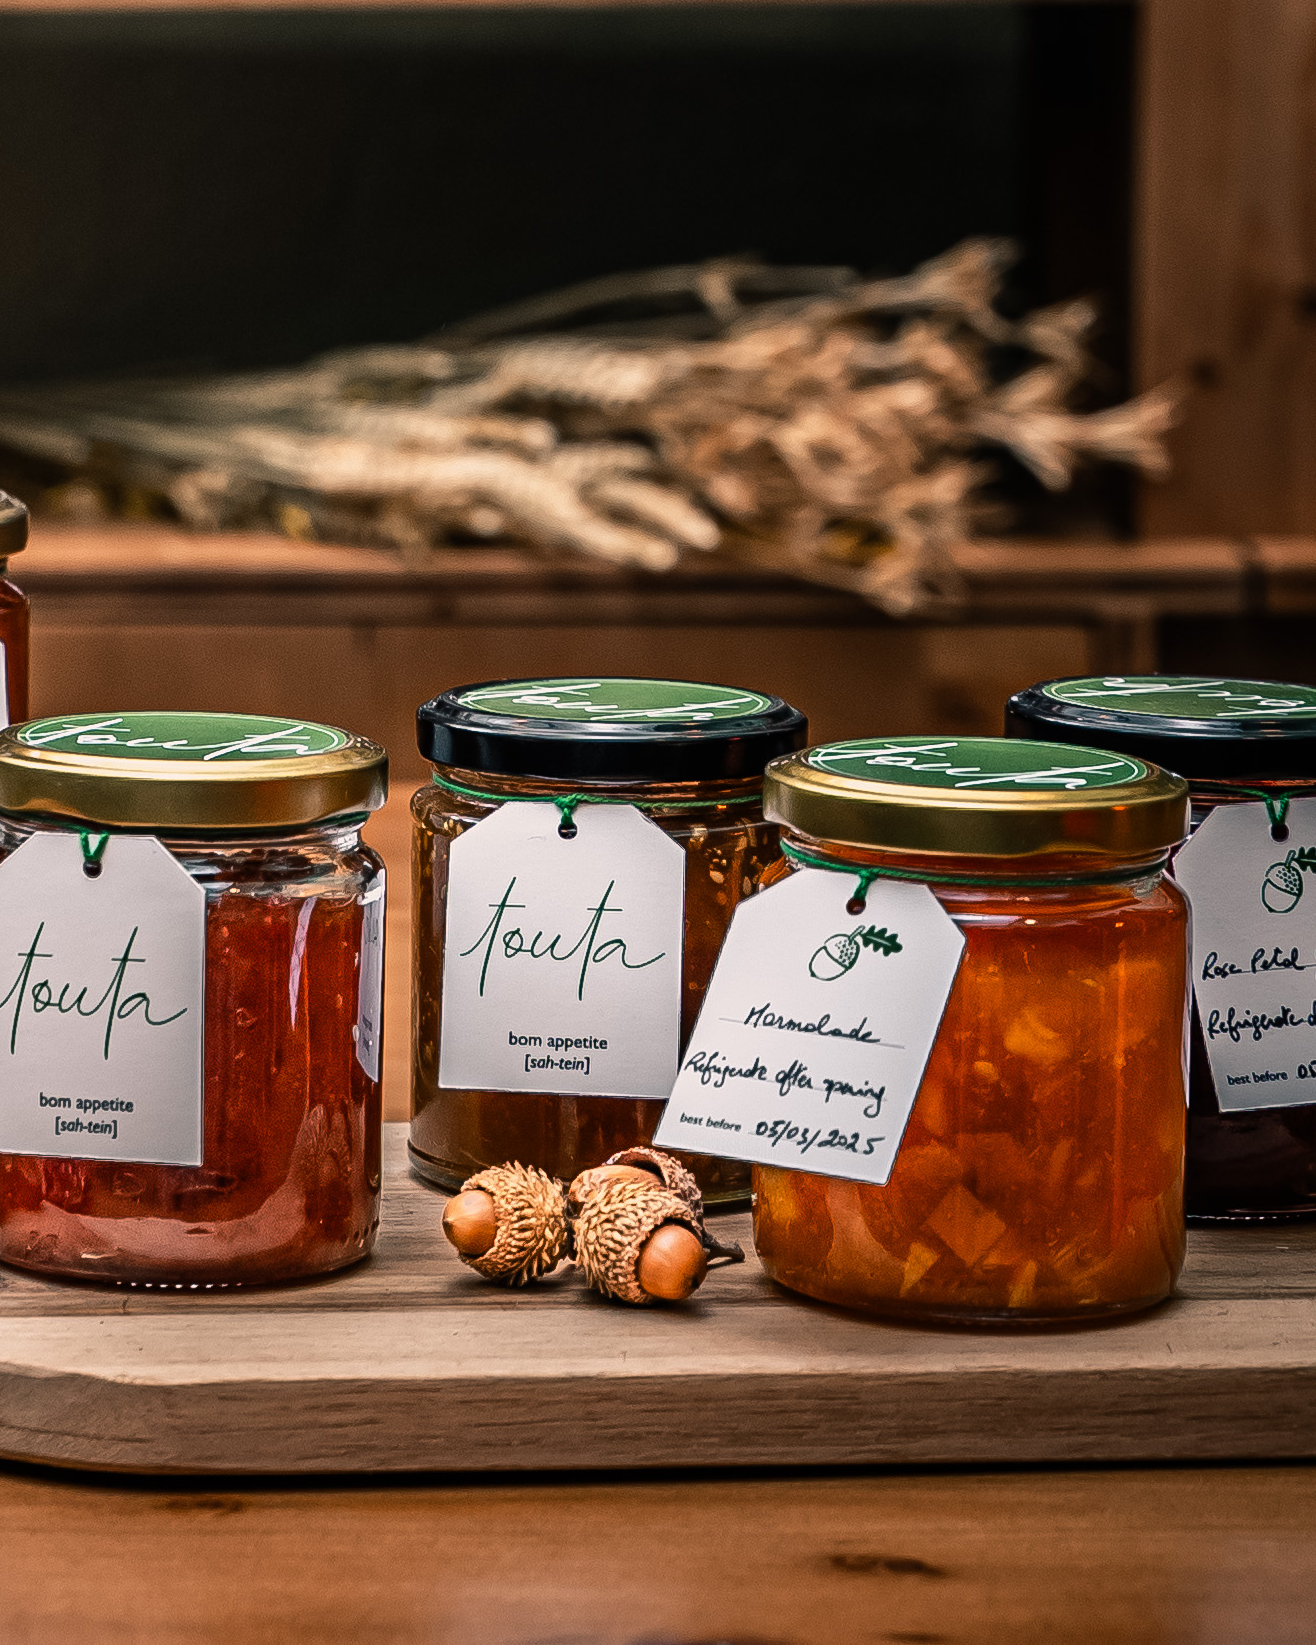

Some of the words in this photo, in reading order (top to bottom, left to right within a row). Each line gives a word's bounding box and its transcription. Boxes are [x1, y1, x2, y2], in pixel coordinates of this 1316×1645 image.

[458, 683, 754, 720] touta
[22, 718, 326, 760] touta
[808, 742, 1125, 789] touta
[460, 876, 666, 1001] touta
[1202, 951, 1242, 981] Rose
[1251, 947, 1305, 974] Petal
[508, 1031, 543, 1046] bom
[546, 1035, 608, 1052] appetite
[524, 1054, 590, 1075] [sah-tein]
[1227, 1074, 1251, 1085] best
[1252, 1070, 1289, 1083] before
[39, 1092, 72, 1108] bom
[75, 1097, 134, 1114] appetite
[54, 1116, 118, 1139] [sah-tein]
[680, 1112, 704, 1126] best
[705, 1117, 742, 1132] before
